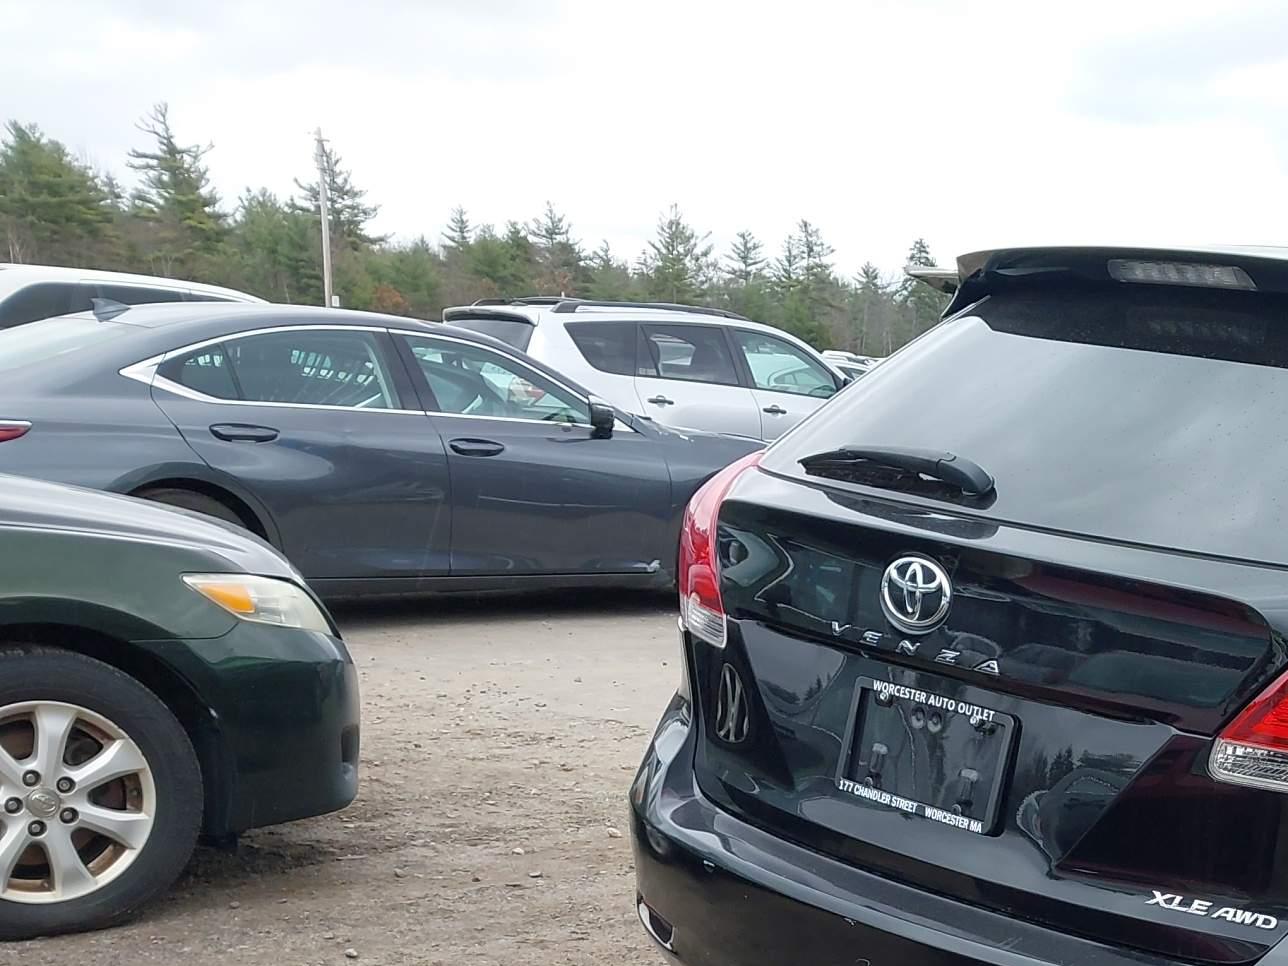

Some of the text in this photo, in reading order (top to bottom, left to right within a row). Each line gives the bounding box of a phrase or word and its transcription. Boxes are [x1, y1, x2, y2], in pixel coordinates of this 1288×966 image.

[831, 620, 1000, 675] VENZA
[873, 680, 995, 721] WORCESTER AUTO OUTLET
[838, 778, 983, 834] 177 CHANDLER STREET WORCESTER MA
[1145, 890, 1278, 930] XLE AWD
